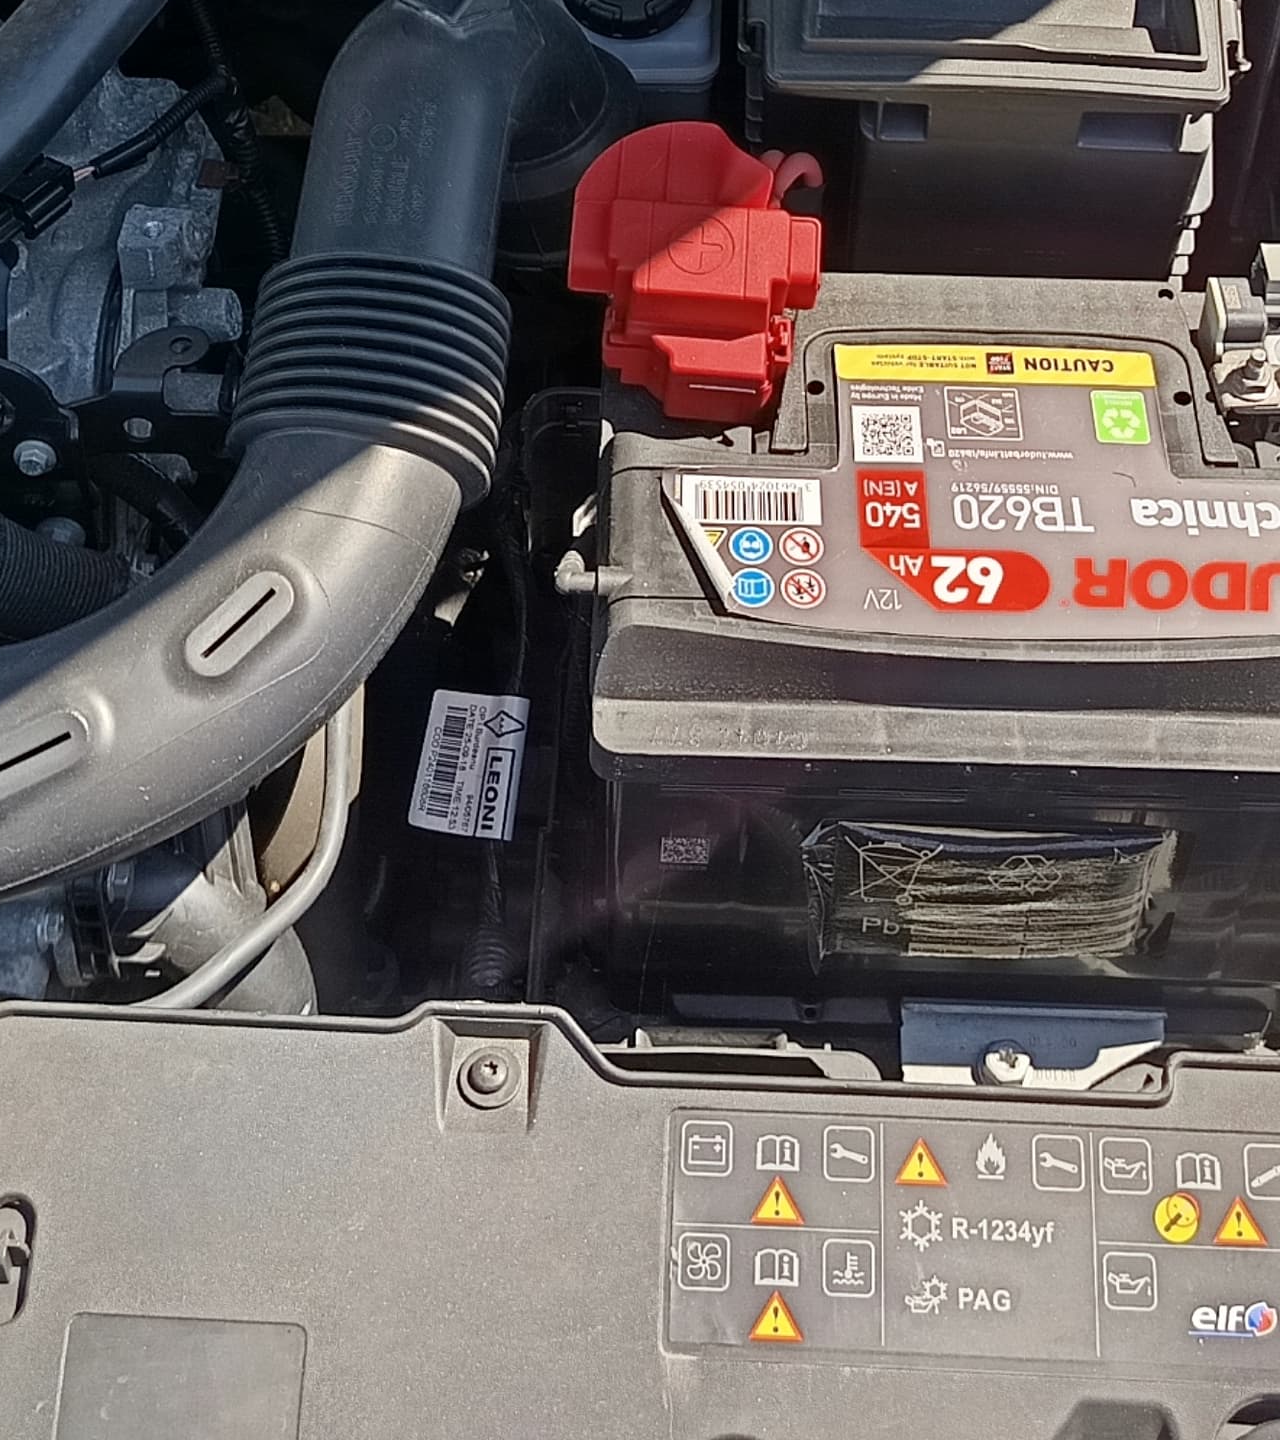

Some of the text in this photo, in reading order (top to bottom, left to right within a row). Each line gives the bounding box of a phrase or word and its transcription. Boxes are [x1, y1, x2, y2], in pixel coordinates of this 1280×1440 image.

[919, 361, 959, 369] SUITABLE
[1023, 356, 1115, 373] CAUTION
[849, 383, 899, 393] Technologies
[861, 391, 890, 401] Europe
[898, 393, 923, 402] Made
[804, 482, 813, 492] 3
[863, 478, 918, 498] A (EN)
[865, 501, 921, 529] 540
[952, 494, 1096, 534] TB620
[888, 554, 1004, 605] 62 Ah
[863, 588, 903, 610] 12V
[480, 755, 504, 831] LEONI
[861, 916, 900, 935] Pb
[951, 1216, 1055, 1249] R-1234yf
[957, 1286, 1012, 1312] PAG
[1191, 1304, 1246, 1332] elf
